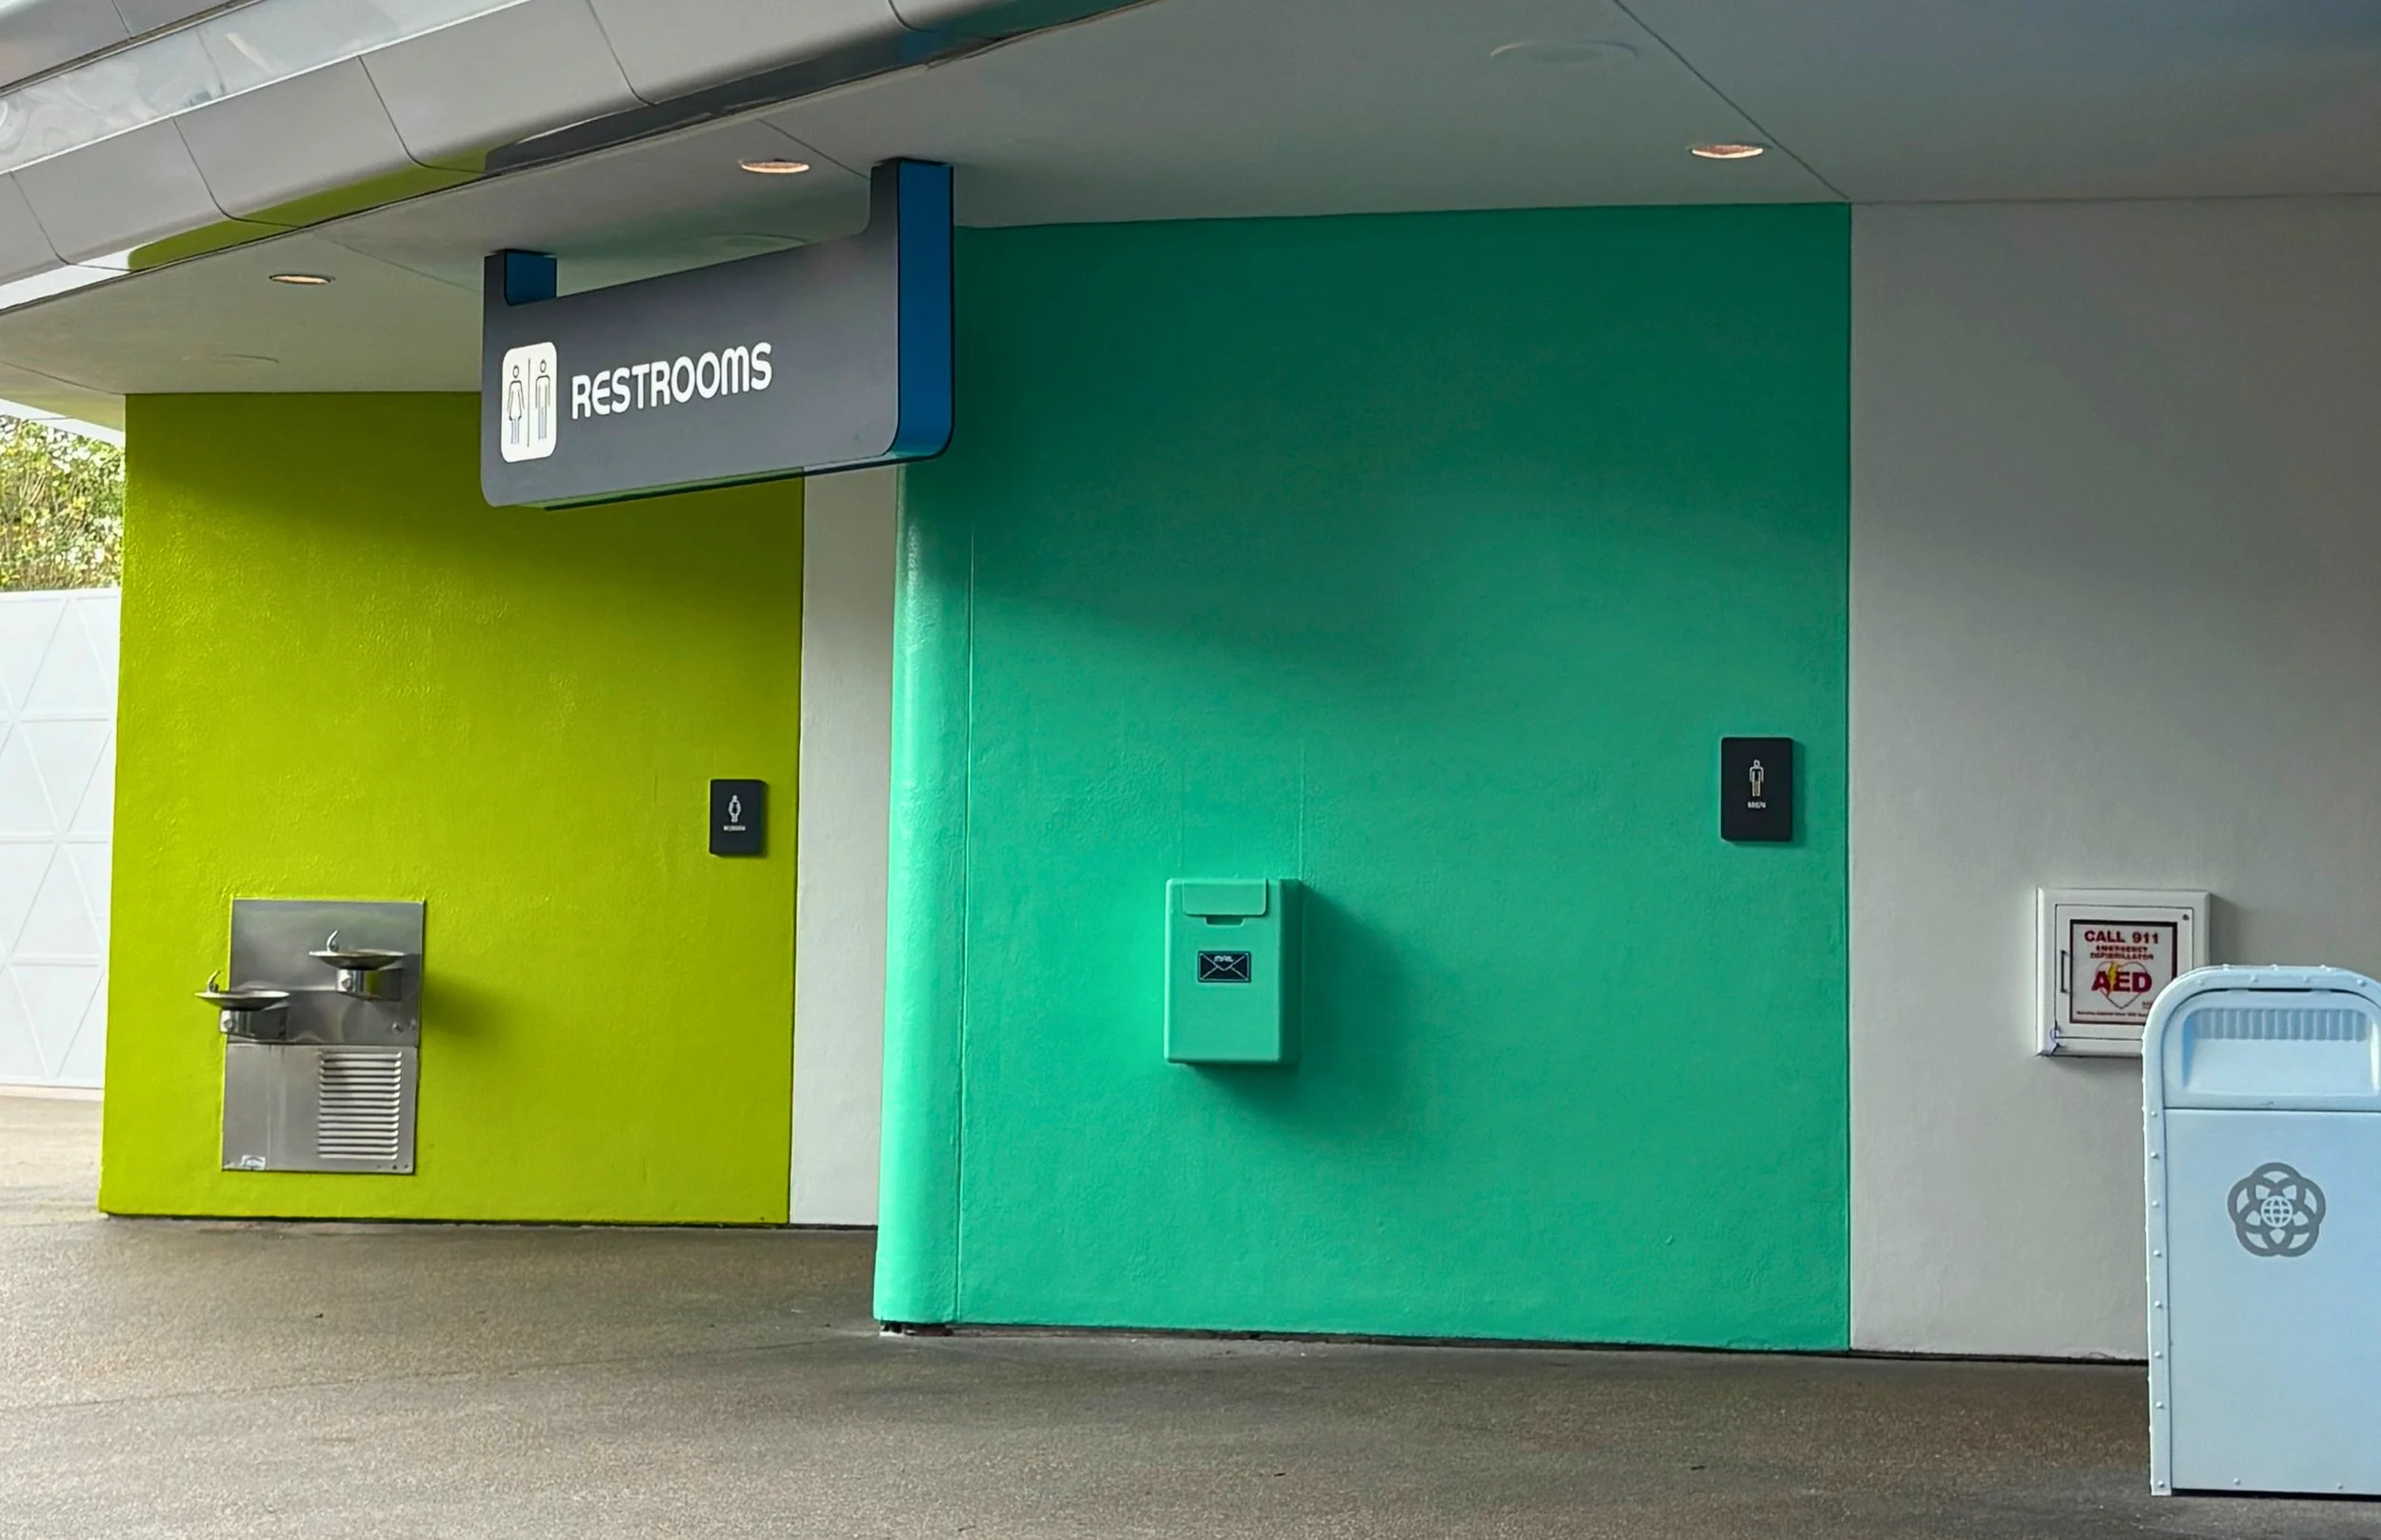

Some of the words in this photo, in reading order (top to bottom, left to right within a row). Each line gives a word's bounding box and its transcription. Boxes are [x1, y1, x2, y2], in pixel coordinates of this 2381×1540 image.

[571, 342, 772, 420] RESTROOMS
[2084, 930, 2126, 943] CALL
[2131, 931, 2159, 945] 911
[2091, 970, 2152, 993] AED
